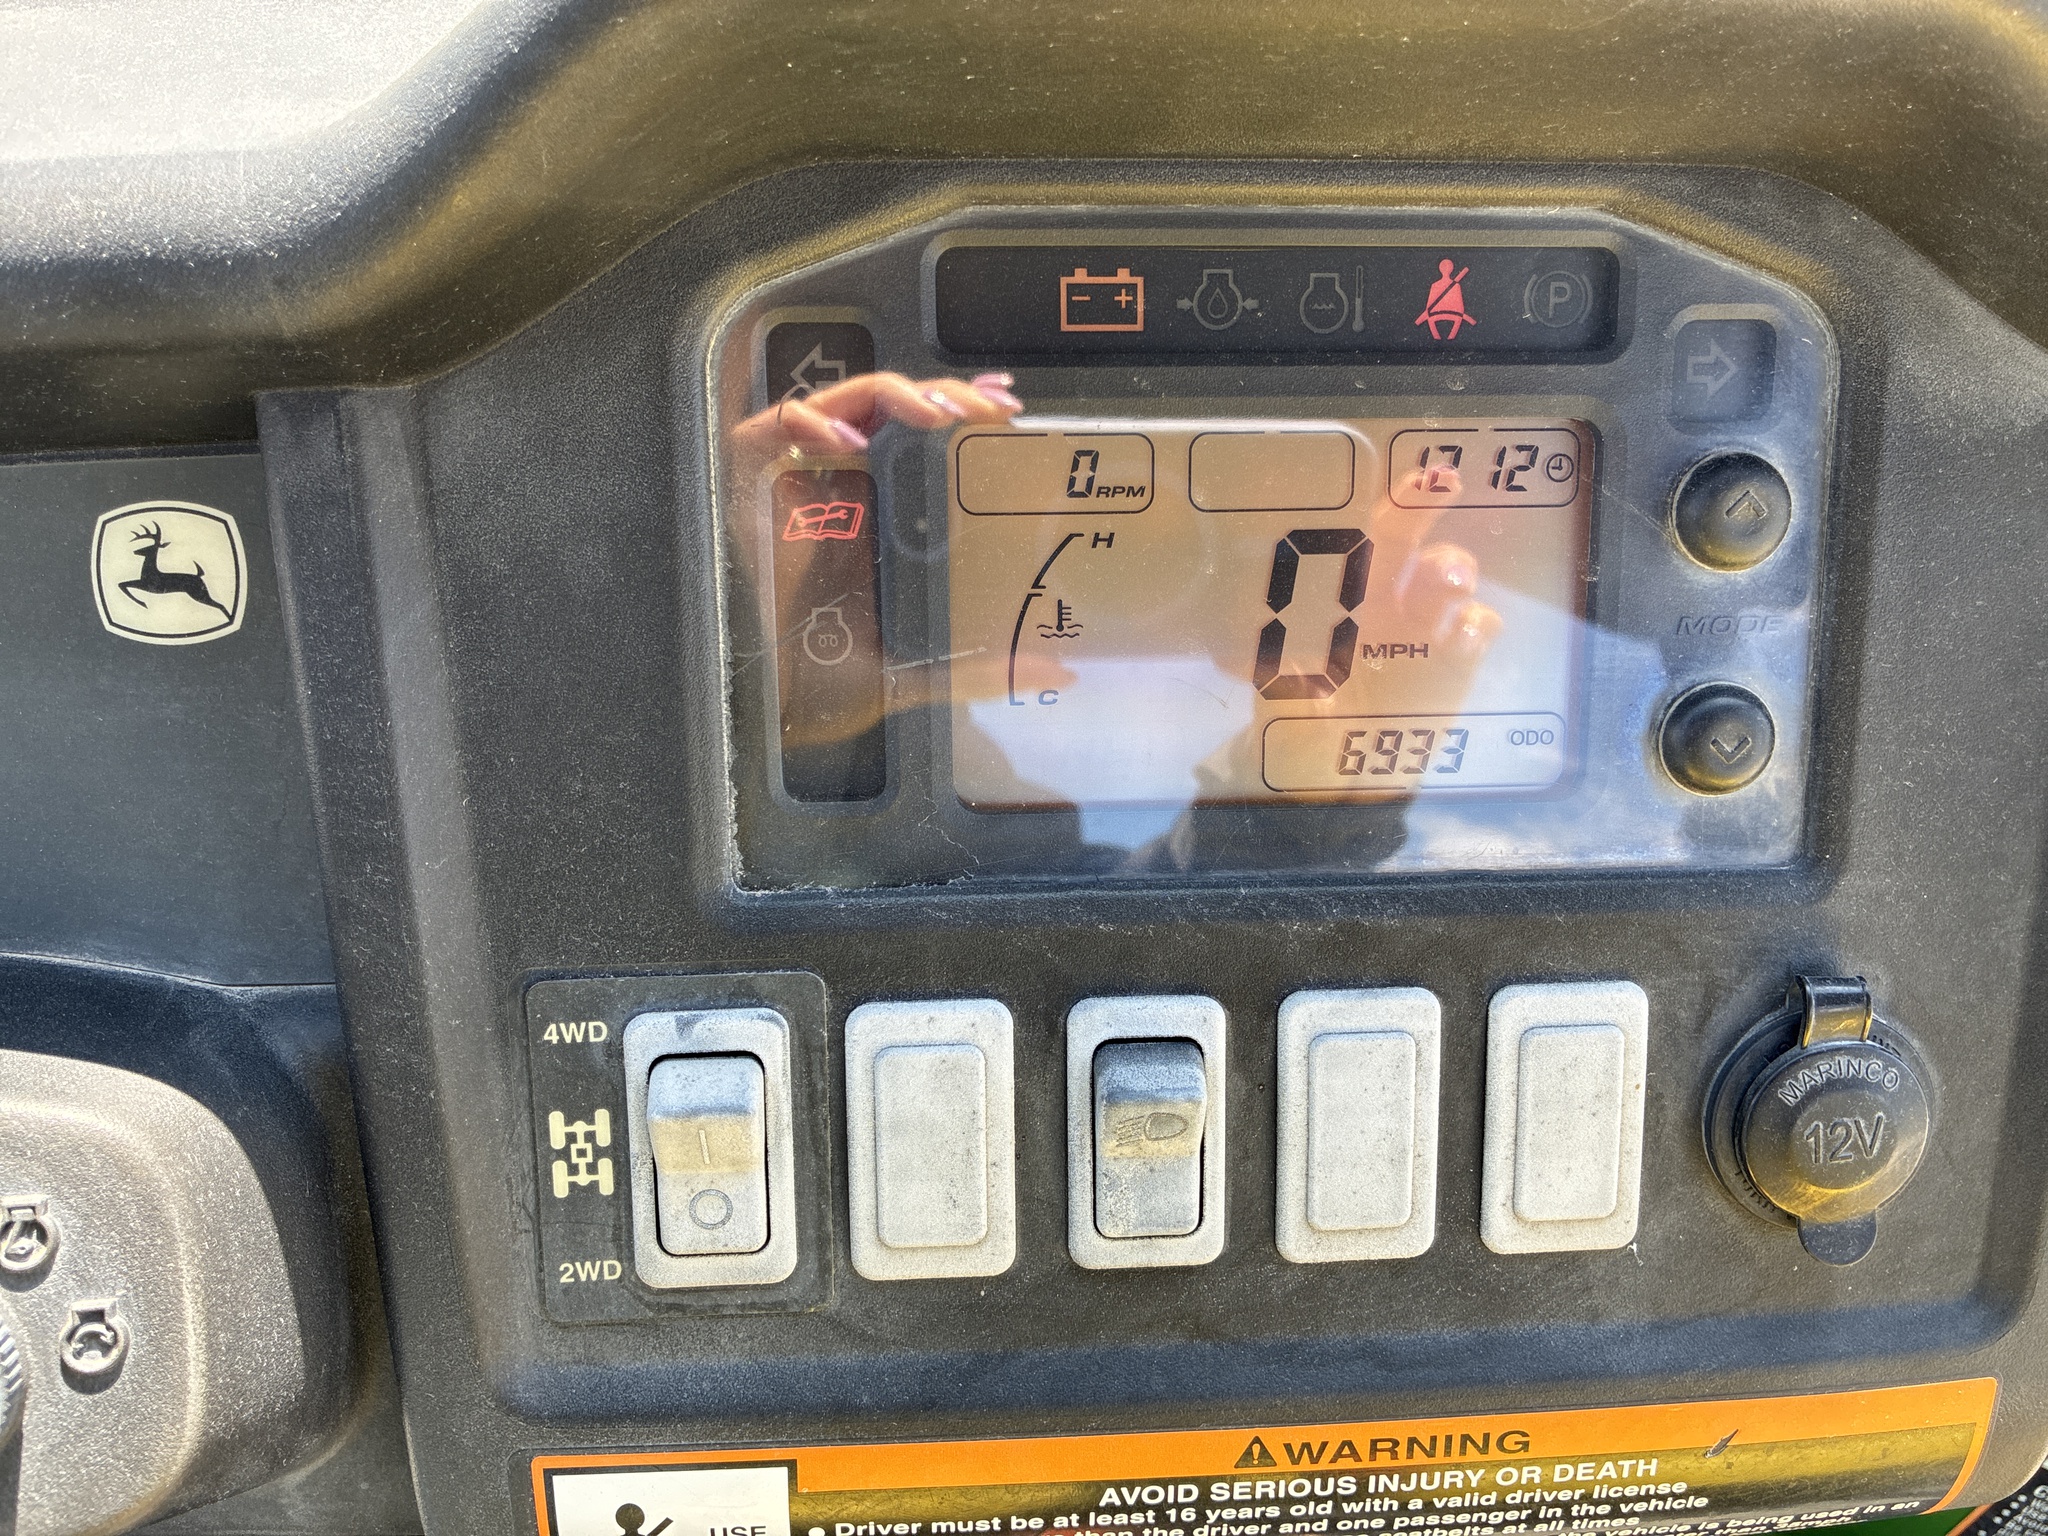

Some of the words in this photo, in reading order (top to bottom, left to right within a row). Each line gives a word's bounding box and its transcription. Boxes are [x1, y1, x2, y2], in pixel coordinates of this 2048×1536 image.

[1067, 449, 1099, 498] 0
[1096, 486, 1146, 499] RPM
[1091, 532, 1115, 548] H
[1252, 528, 1375, 700] 0
[1361, 643, 1429, 660] MPH
[1676, 615, 1785, 636] MODE
[1037, 690, 1059, 706] C
[1338, 728, 1470, 776] 6933
[1509, 729, 1555, 747] ODO
[543, 1020, 608, 1045] 4WD
[1777, 1057, 1901, 1108] MARINCO
[1804, 1113, 1886, 1165] 12V
[558, 1260, 623, 1283] 2WD
[1283, 1429, 1531, 1466] WARNING
[1099, 1484, 1199, 1507] AVOID
[1210, 1476, 1357, 1501] SERIOUS
[1368, 1468, 1485, 1494] INJURY
[1495, 1465, 1541, 1485] OR
[1553, 1458, 1658, 1483] DEATH
[835, 1520, 921, 1536] Driver
[931, 1516, 1002, 1533] must
[1010, 1514, 1044, 1531] be
[1053, 1513, 1080, 1528] at
[1088, 1509, 1155, 1526] least
[1165, 1507, 1196, 1523] 16
[1205, 1505, 1281, 1525] years
[1289, 1500, 1333, 1516] old
[1341, 1497, 1398, 1513] with
[1407, 1498, 1423, 1510] a
[1432, 1491, 1498, 1508] valid
[1505, 1486, 1585, 1505] driver
[1592, 1481, 1688, 1500] license
[1142, 1526, 1184, 1536] the
[1192, 1523, 1272, 1536] driver
[1278, 1518, 1328, 1534] and
[1336, 1517, 1386, 1532] one
[1393, 1507, 1532, 1530] passenger
[1539, 1506, 1562, 1520] in
[1571, 1503, 1611, 1517] the
[1620, 1496, 1709, 1513] vehicle
[1502, 1523, 1528, 1534] at
[1534, 1519, 1565, 1533] all
[1572, 1516, 1640, 1530] times
[1605, 1523, 1692, 1536] vehicle
[1698, 1521, 1720, 1531] is
[1726, 1515, 1795, 1530] being
[1800, 1506, 1860, 1520] used
[1862, 1504, 1889, 1514] in
[1890, 1500, 1921, 1511] an
